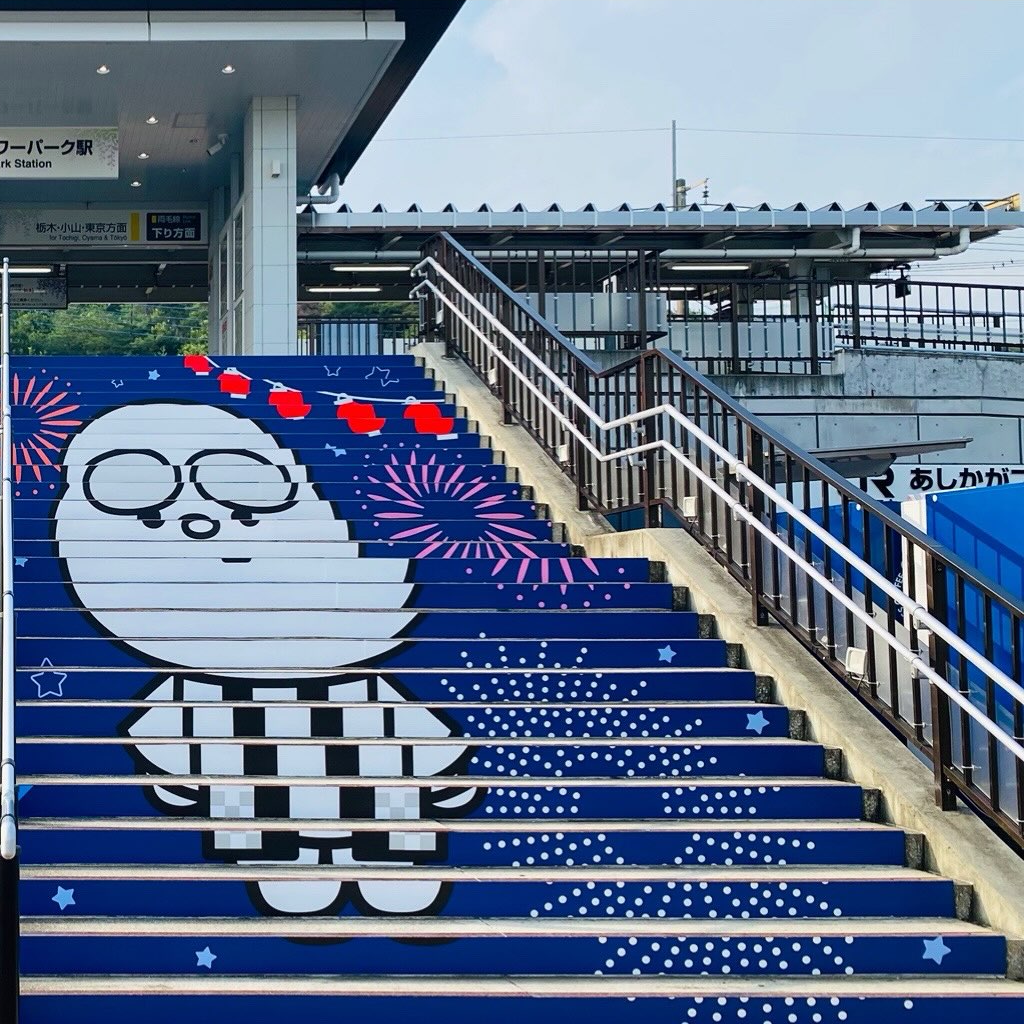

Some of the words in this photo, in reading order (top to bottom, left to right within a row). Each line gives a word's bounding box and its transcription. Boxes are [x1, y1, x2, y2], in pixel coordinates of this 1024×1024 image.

[15, 159, 52, 169] Station
[36, 222, 127, 234] 栃木・小山・東京方面
[152, 227, 196, 239] 下り方面
[910, 467, 1024, 491] あしかが
